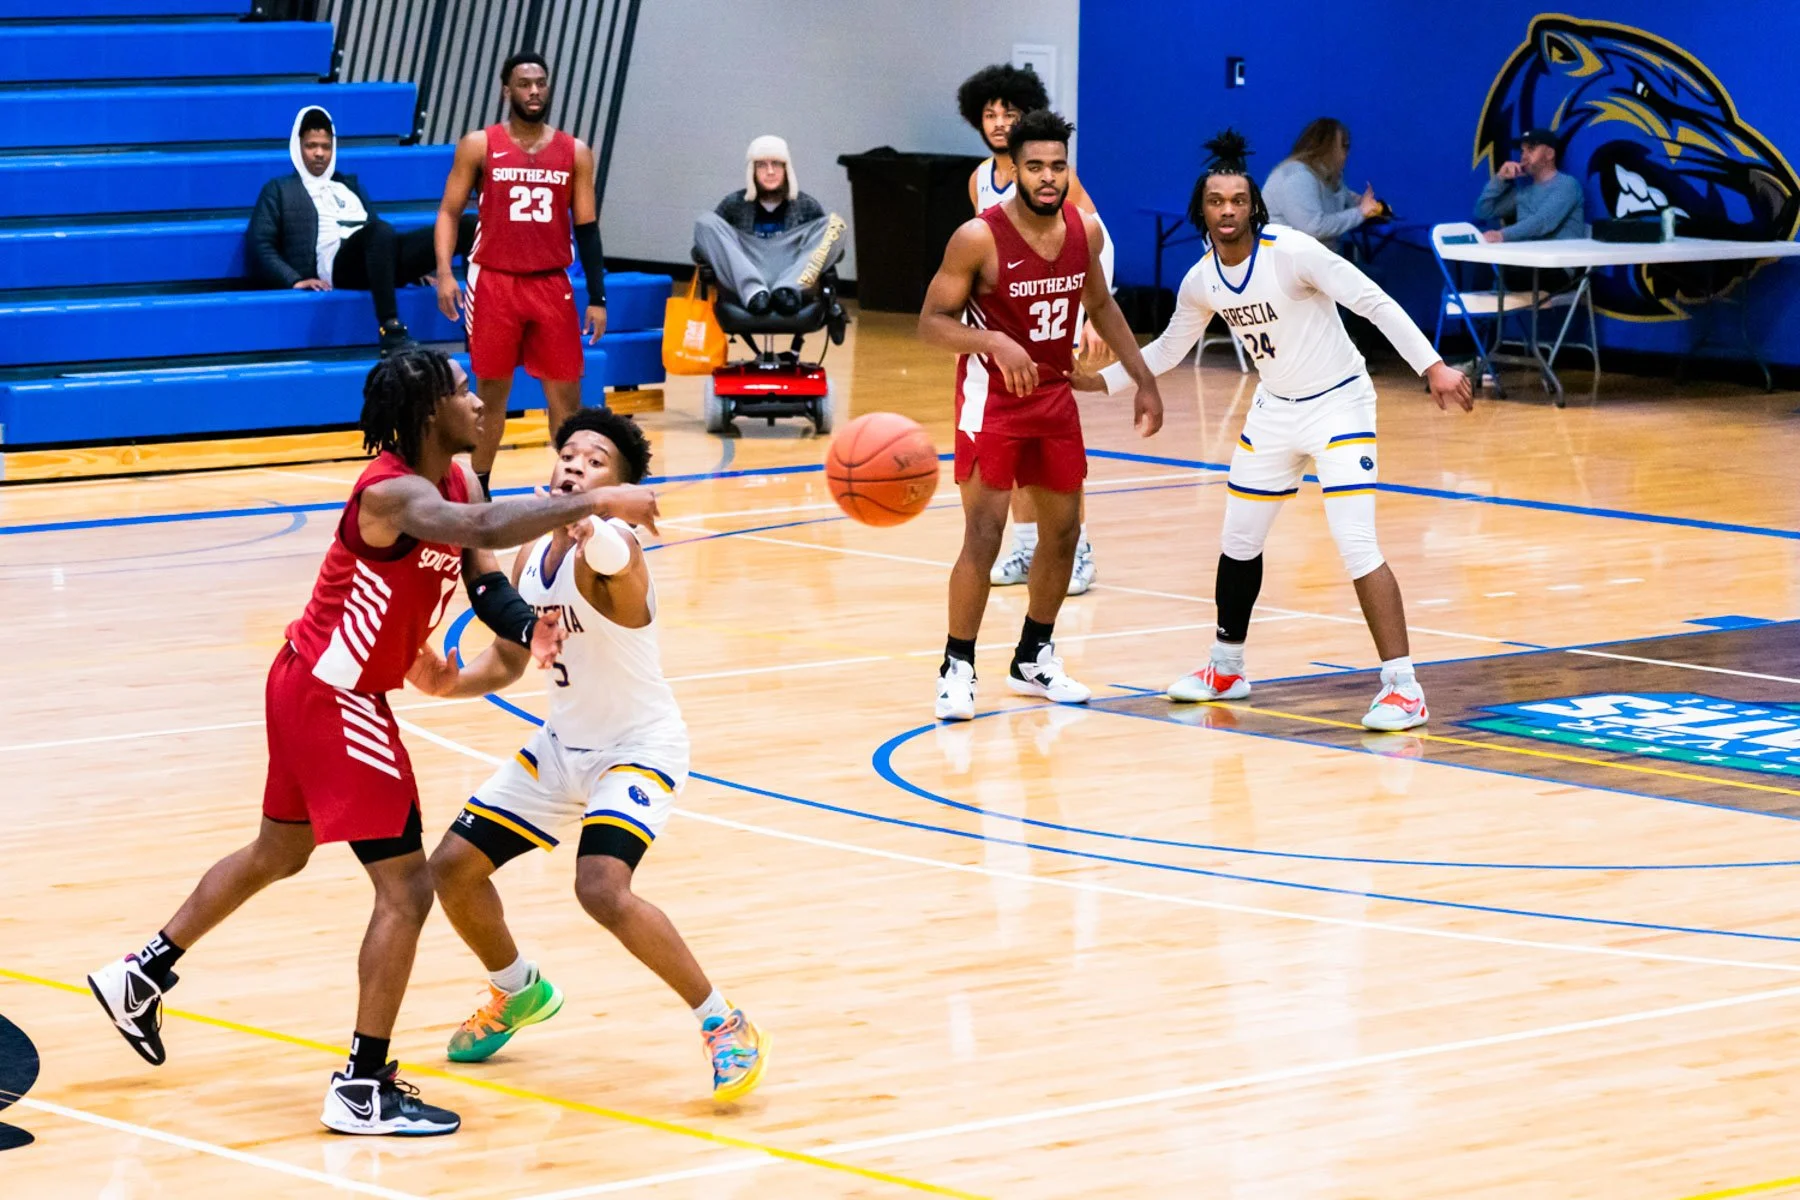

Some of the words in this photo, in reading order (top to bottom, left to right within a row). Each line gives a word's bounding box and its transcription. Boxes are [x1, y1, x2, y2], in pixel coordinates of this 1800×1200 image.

[492, 167, 570, 186] SOUTHEAST
[509, 185, 554, 223] 23
[1009, 272, 1086, 298] SOUTHEAST
[1029, 298, 1069, 342] 32
[1222, 302, 1279, 327] BRESCIA
[1243, 332, 1276, 360] 24
